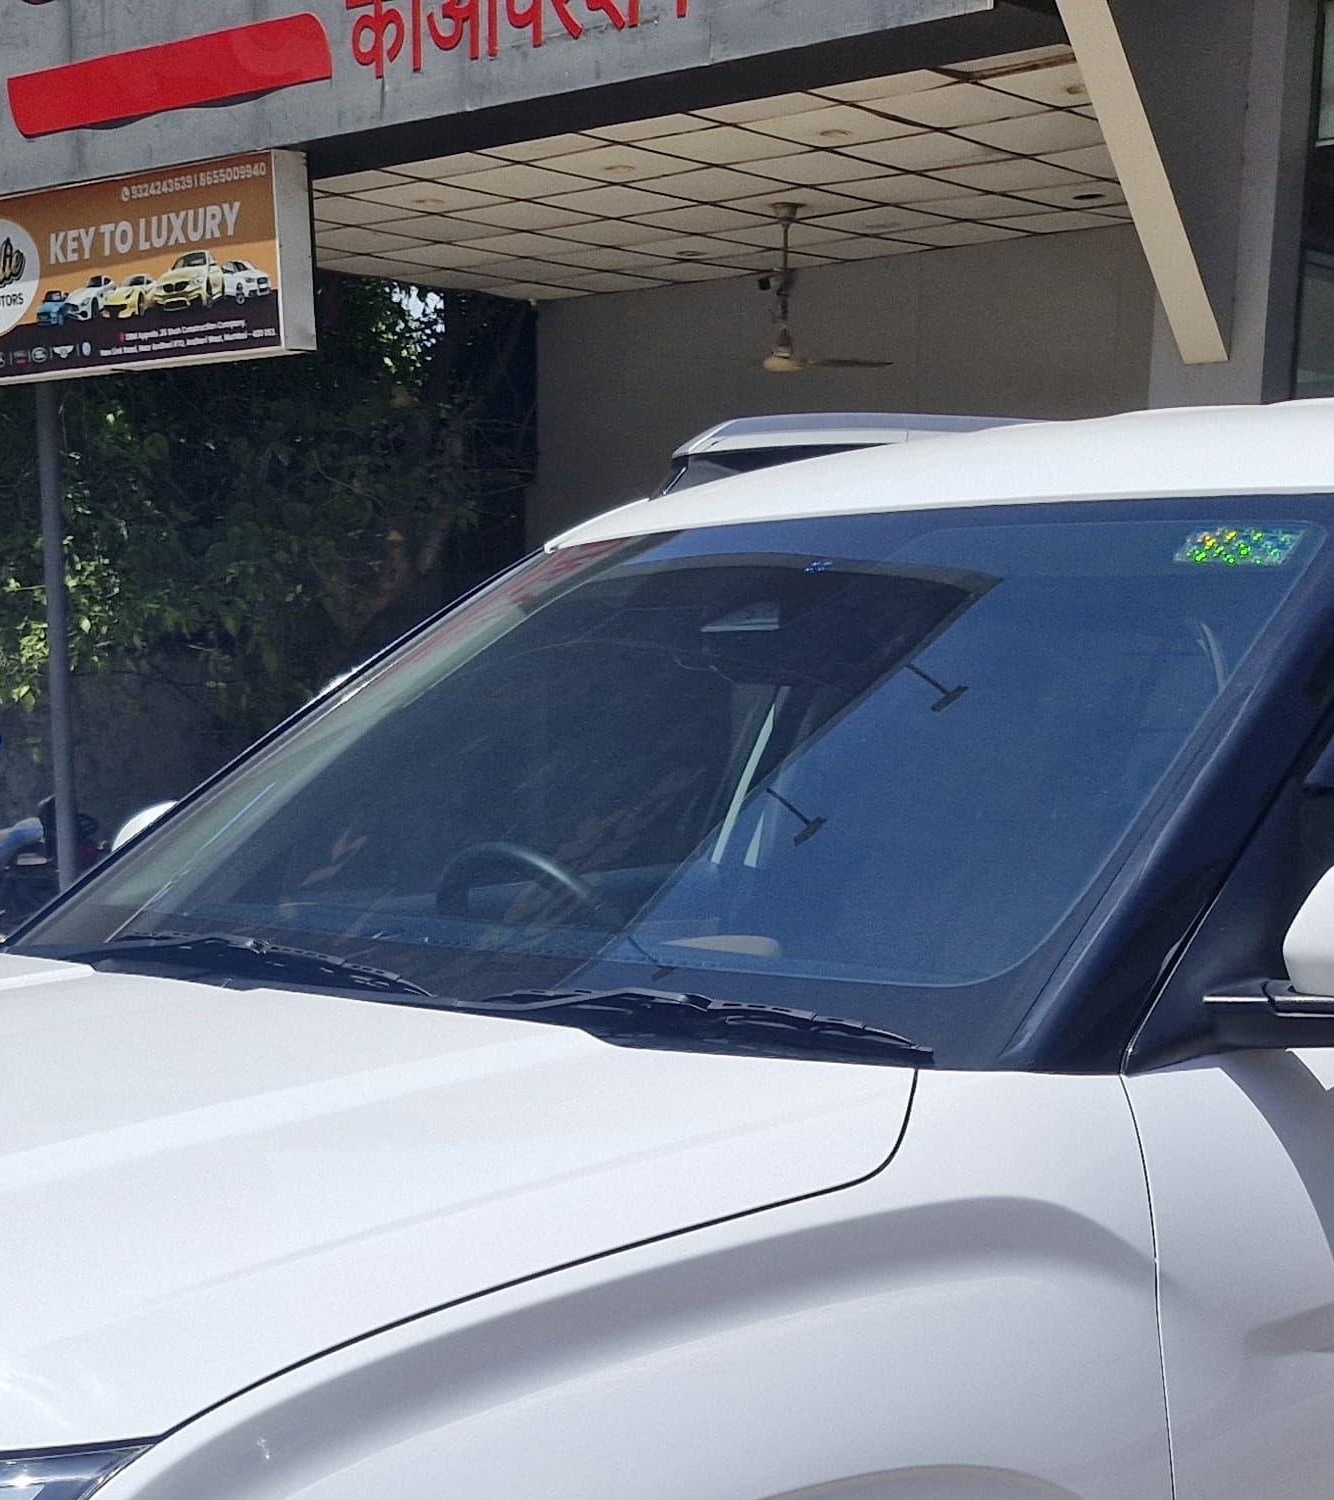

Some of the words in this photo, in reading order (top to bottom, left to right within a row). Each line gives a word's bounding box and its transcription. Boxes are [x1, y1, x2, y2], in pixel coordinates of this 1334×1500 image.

[49, 225, 97, 265] KEY
[99, 220, 134, 257] TO
[138, 200, 241, 251] LUXURY
